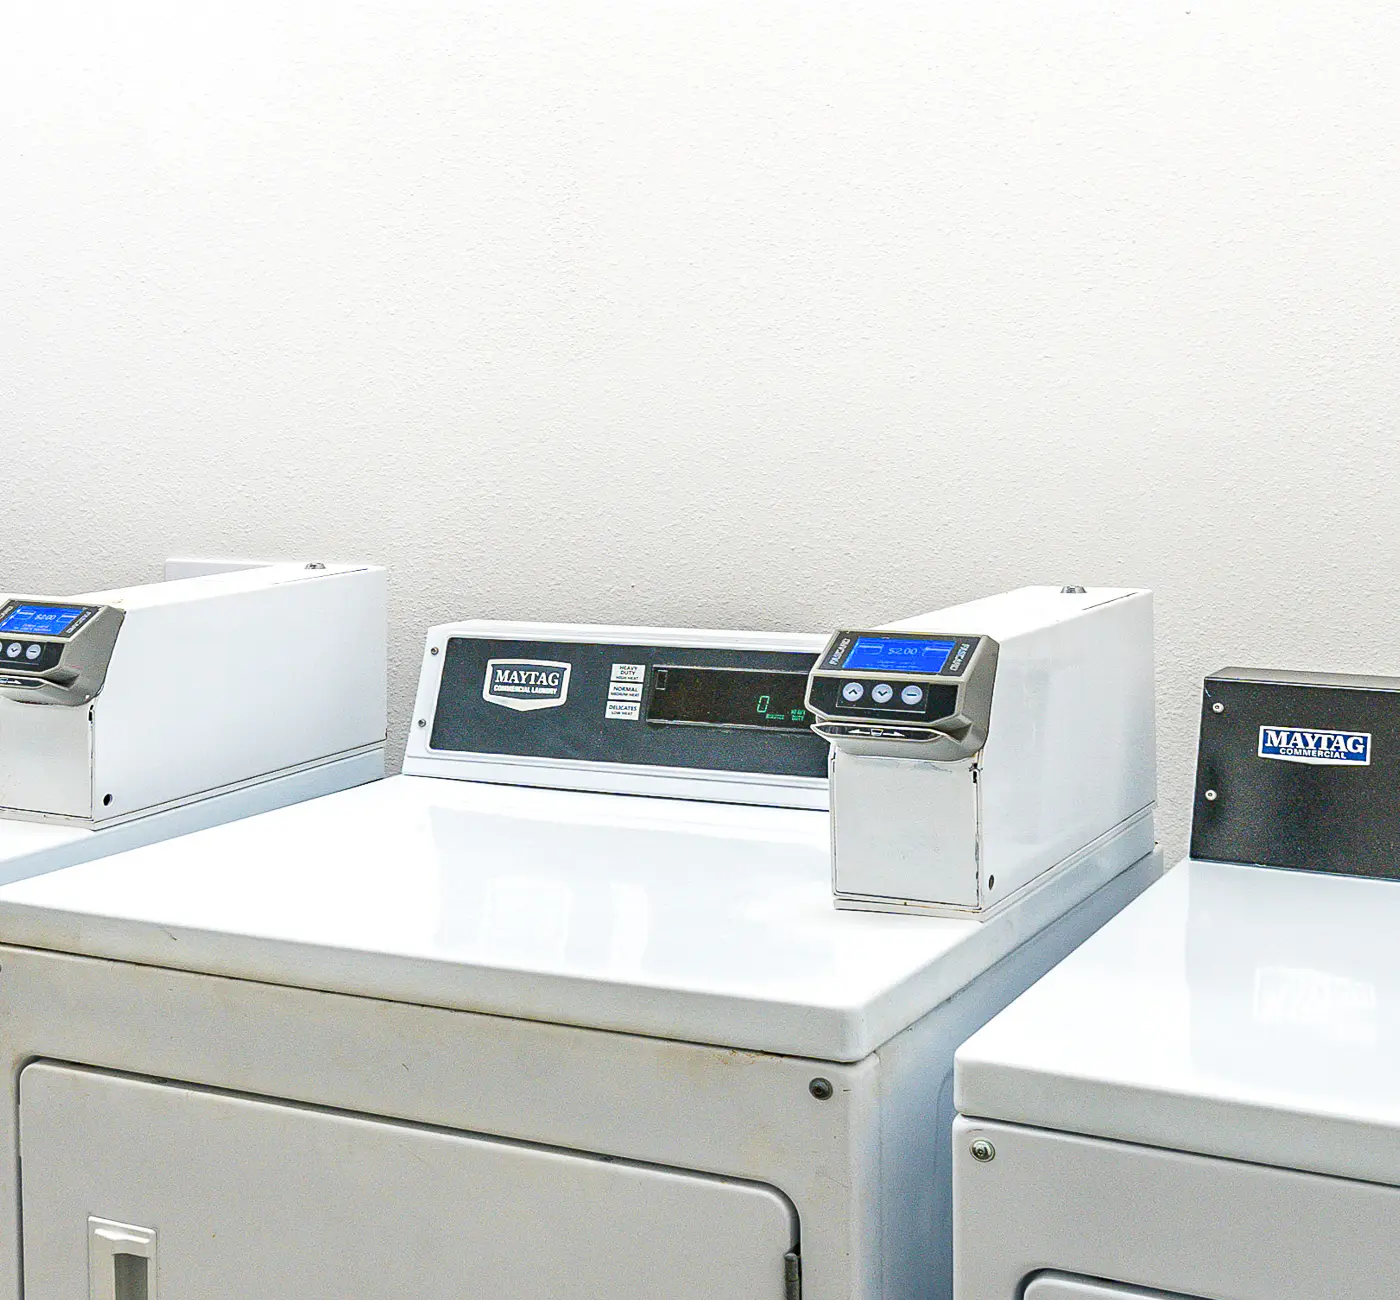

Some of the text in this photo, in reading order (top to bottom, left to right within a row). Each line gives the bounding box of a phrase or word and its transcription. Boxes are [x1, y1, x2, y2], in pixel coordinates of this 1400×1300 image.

[887, 647, 918, 655] $2.00
[495, 670, 559, 686] MAYTAG
[1265, 731, 1365, 753] MAYTAG
[1279, 748, 1347, 759] COMMERCIAL
